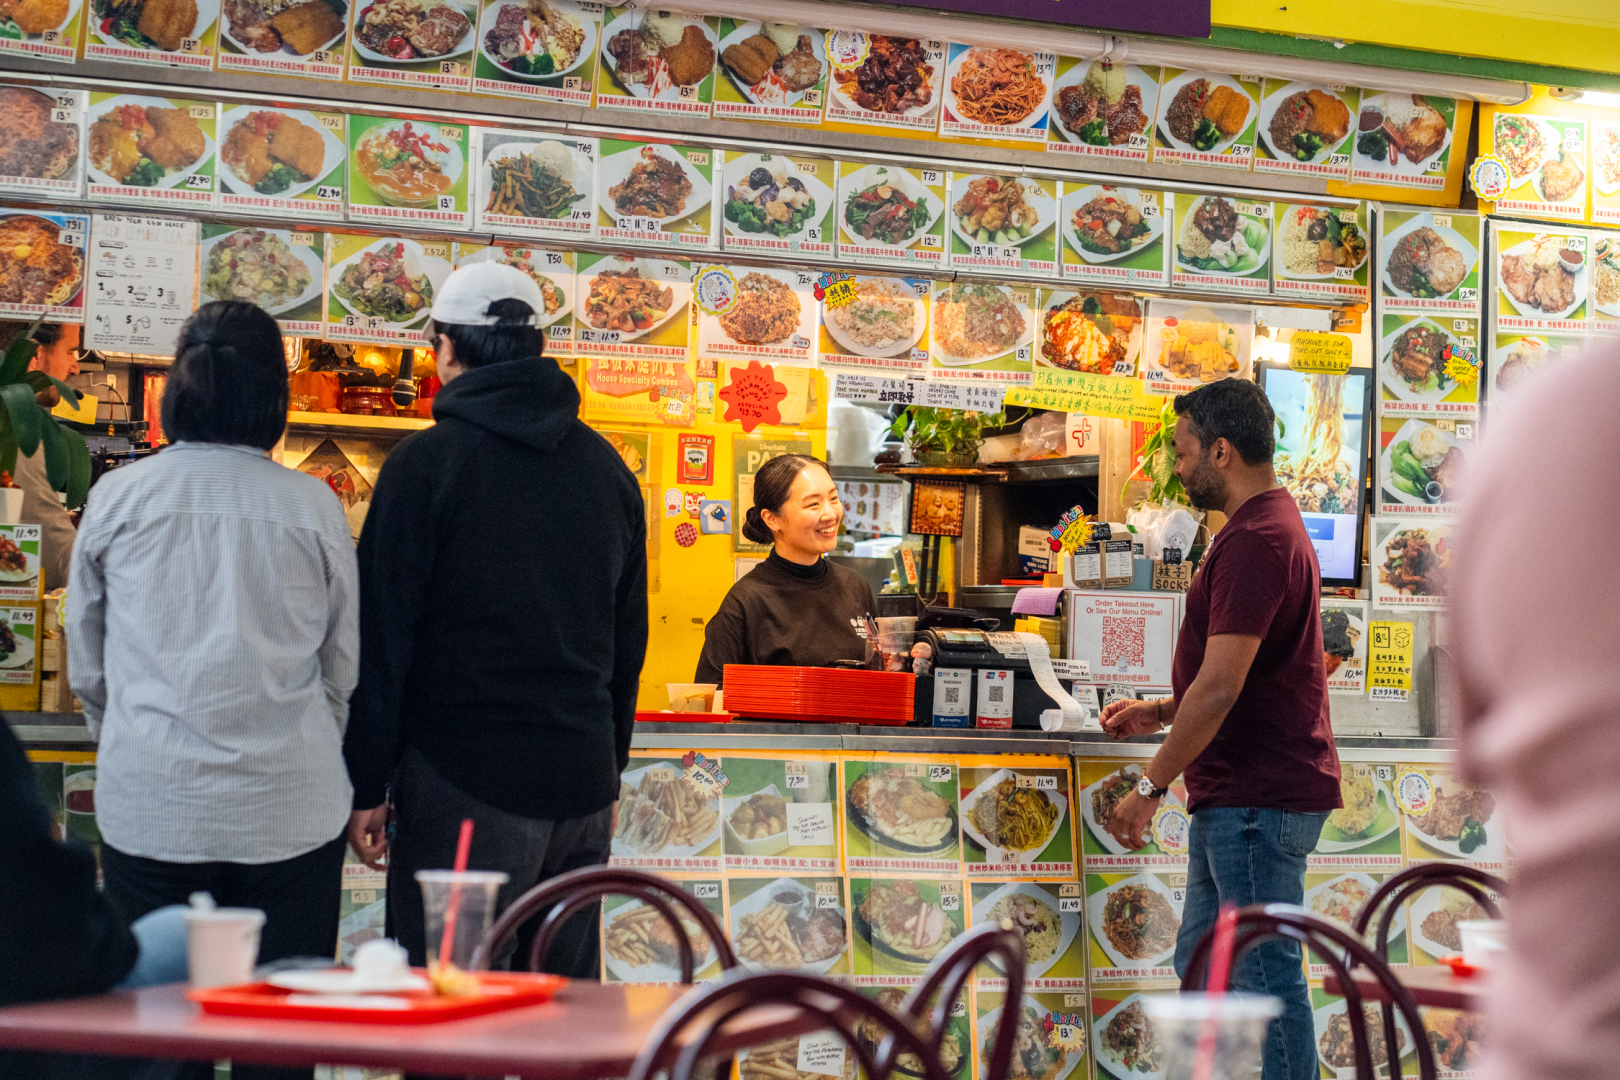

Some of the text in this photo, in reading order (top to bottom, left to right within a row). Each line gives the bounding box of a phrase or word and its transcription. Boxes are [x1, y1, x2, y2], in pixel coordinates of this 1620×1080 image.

[922, 171, 937, 182] T73
[318, 187, 341, 199] 12.90
[67, 219, 82, 230] T91
[546, 253, 562, 264] T50
[798, 274, 813, 285] T24
[914, 285, 928, 294] T23
[596, 373, 679, 387] House Specialty Combos
[759, 442, 787, 451] DineSafe
[1050, 519, 1067, 540] Hot
[1062, 505, 1083, 525] item
[1155, 579, 1189, 590] SOCKS
[1095, 600, 1155, 609] Order Takeout Here
[1086, 607, 1163, 617] Or See Our Menu Online!
[1074, 686, 1093, 695] Google
[929, 767, 951, 779] 15.50
[1037, 777, 1054, 788] 11.49
[695, 885, 718, 896] 10.60
[818, 896, 838, 907] 10.60
[1061, 900, 1079, 910] 11.49
[1053, 1012, 1069, 1025] Hot
